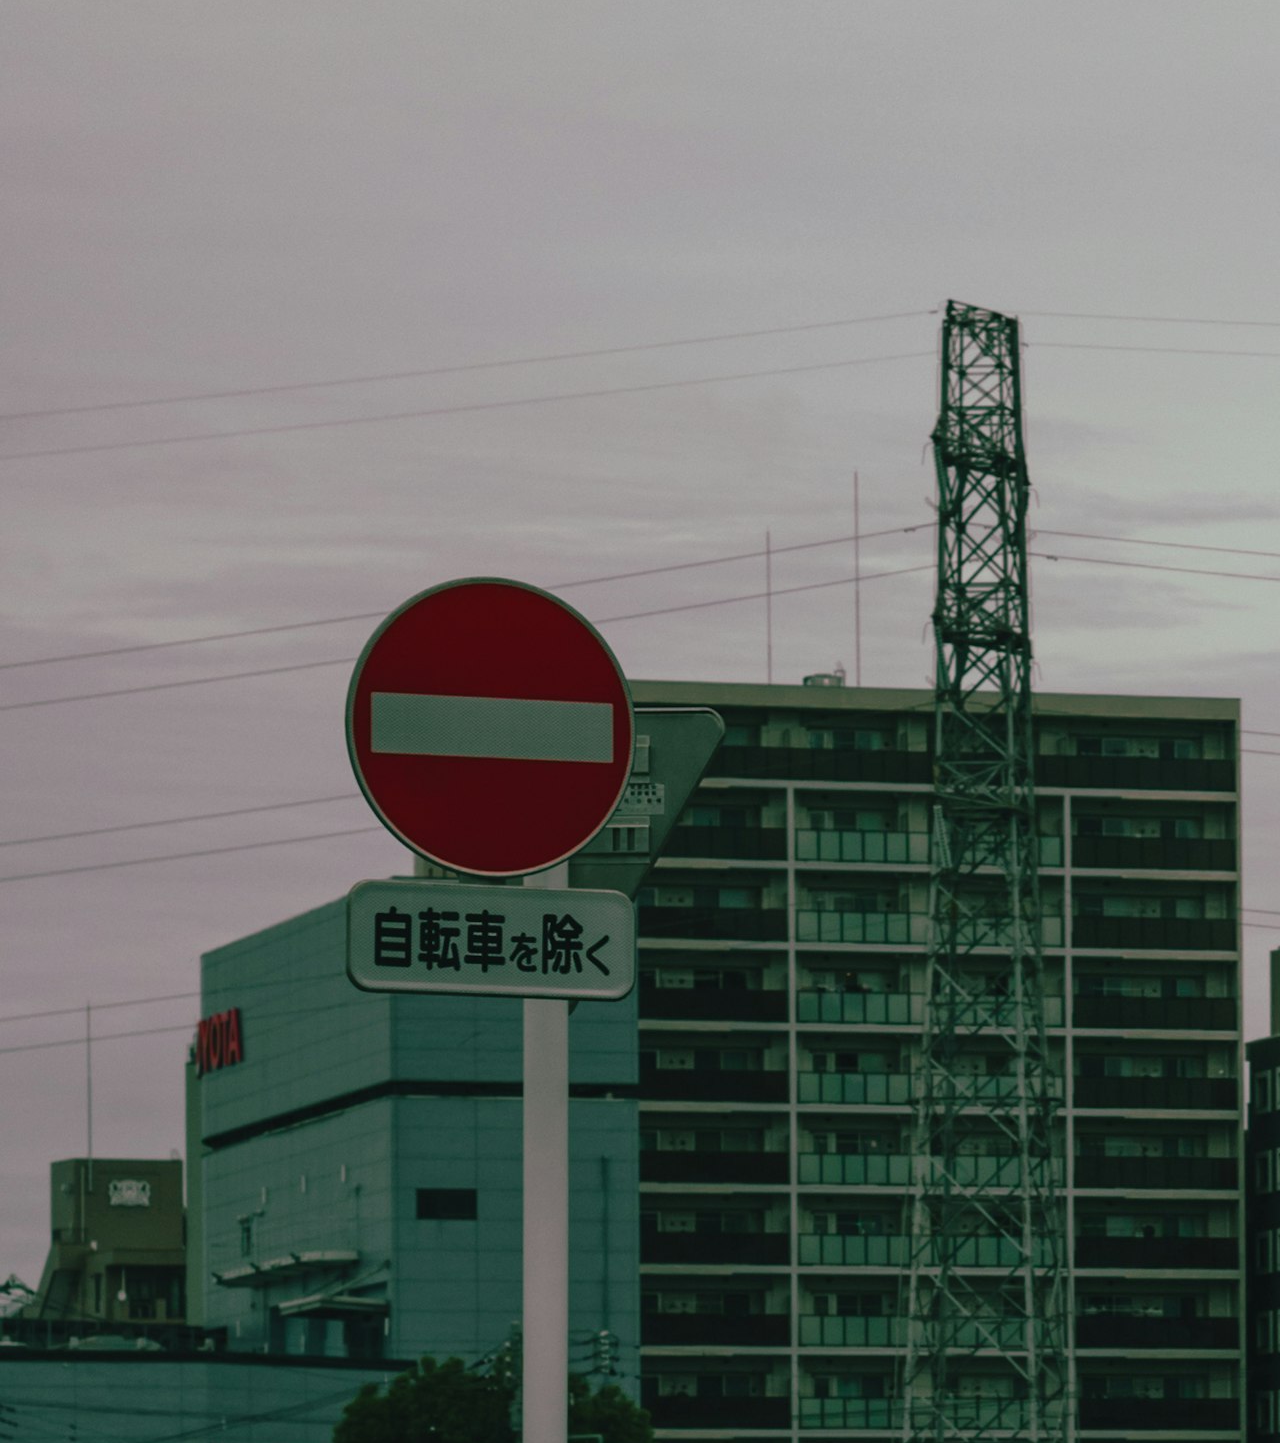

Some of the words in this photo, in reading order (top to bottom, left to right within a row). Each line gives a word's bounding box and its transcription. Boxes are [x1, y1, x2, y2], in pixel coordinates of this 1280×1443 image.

[374, 906, 610, 976] 自転車を除く
